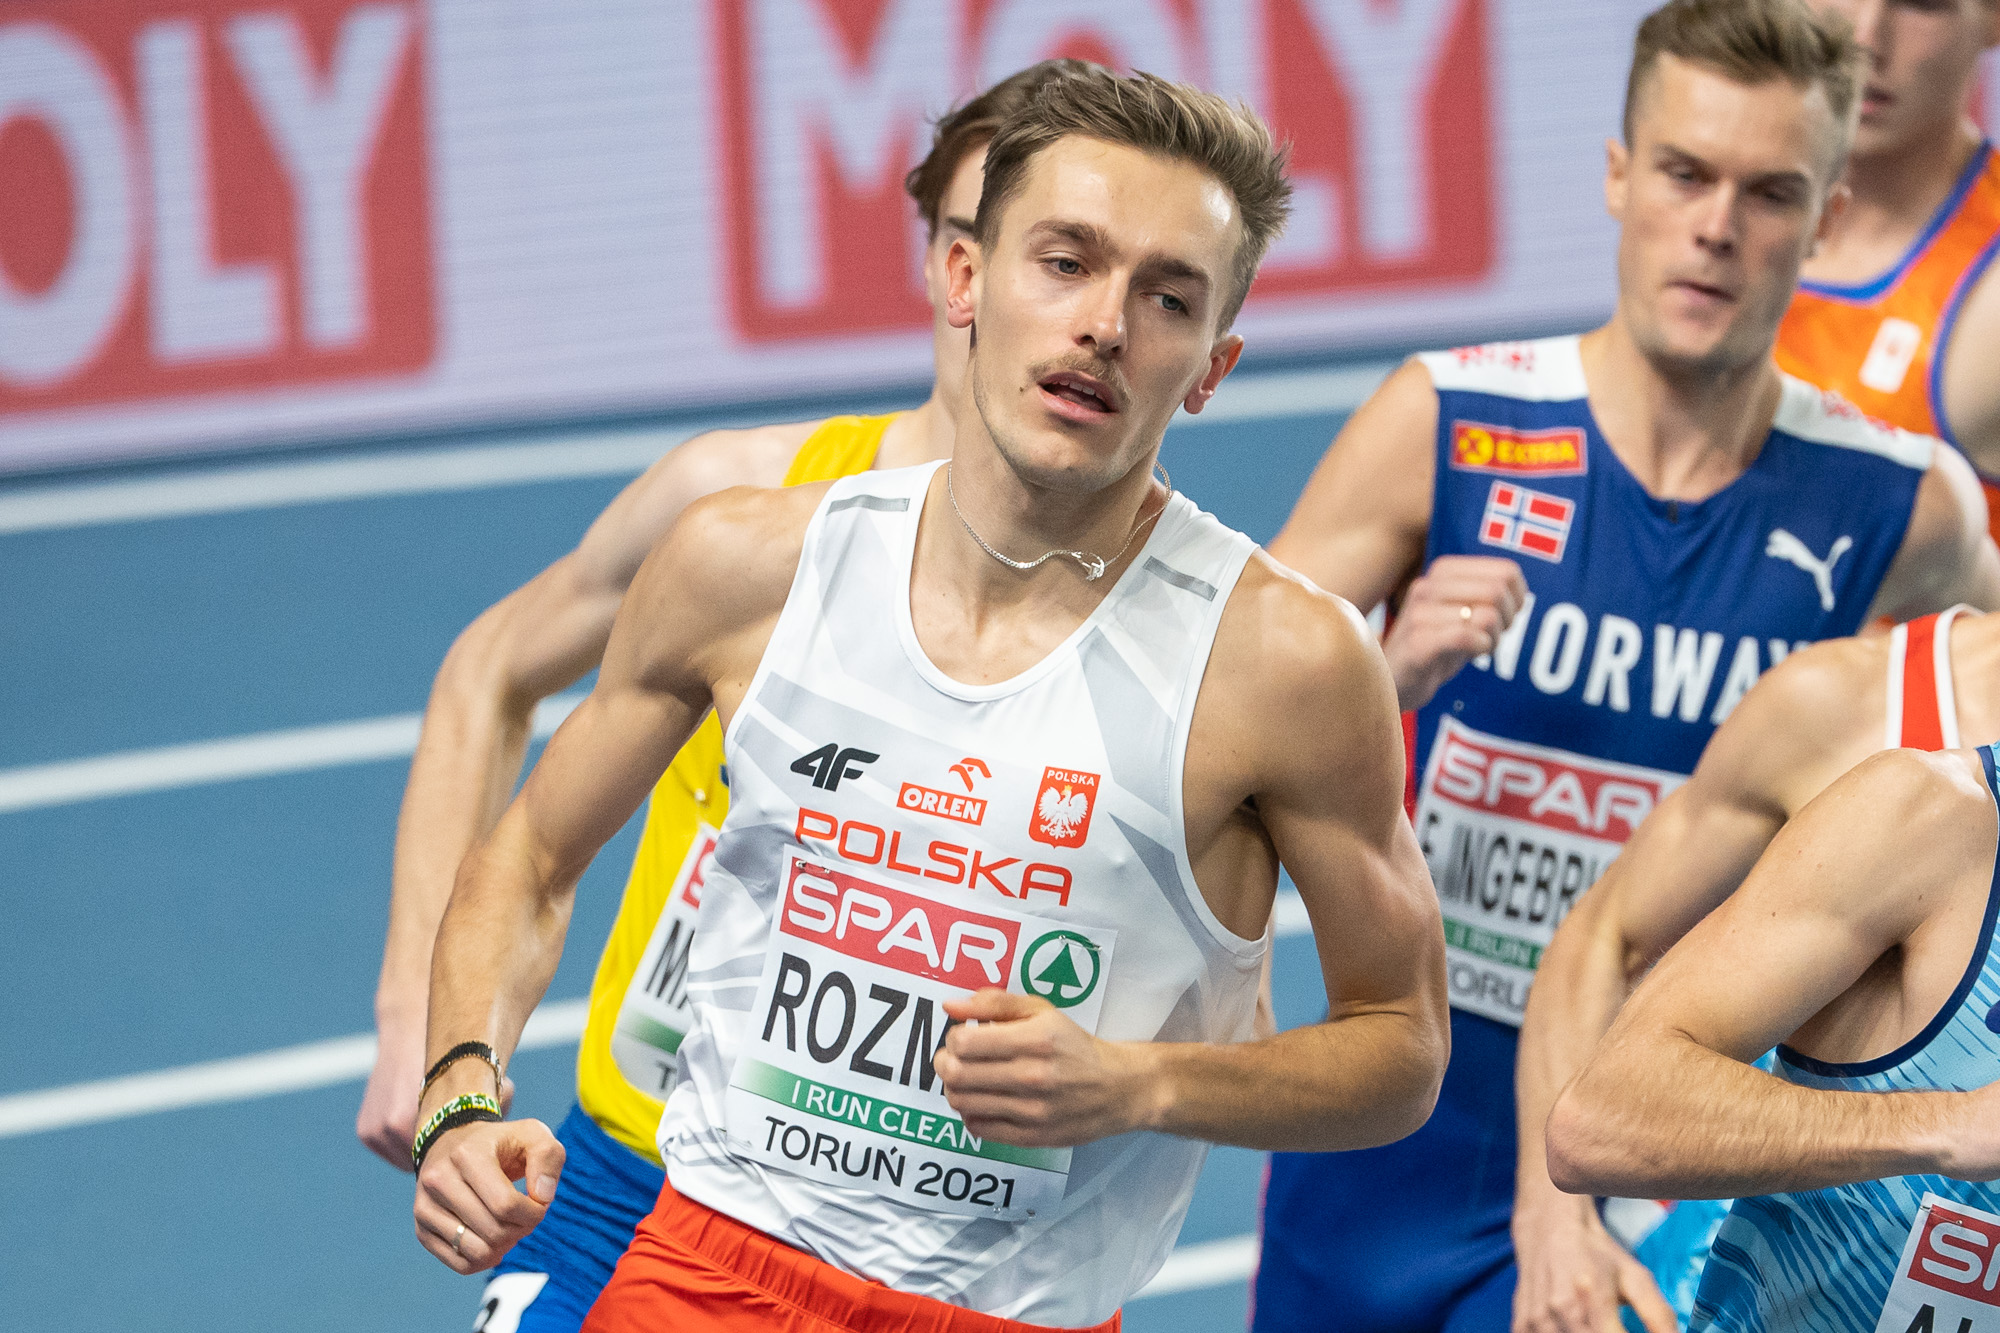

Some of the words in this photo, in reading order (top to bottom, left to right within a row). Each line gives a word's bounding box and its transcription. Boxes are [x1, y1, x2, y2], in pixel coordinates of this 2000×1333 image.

[790, 743, 880, 792] 4F
[1046, 769, 1095, 786] POLSKA
[903, 787, 984, 821] ORLEN
[795, 807, 1073, 907] POLSKA
[787, 872, 1008, 984] SPAR
[791, 1080, 801, 1104] I
[806, 1084, 872, 1125] RUN
[879, 1106, 983, 1152] CLEAN
[765, 1115, 906, 1187] TORUŃ
[914, 1161, 1015, 1208] 2021
